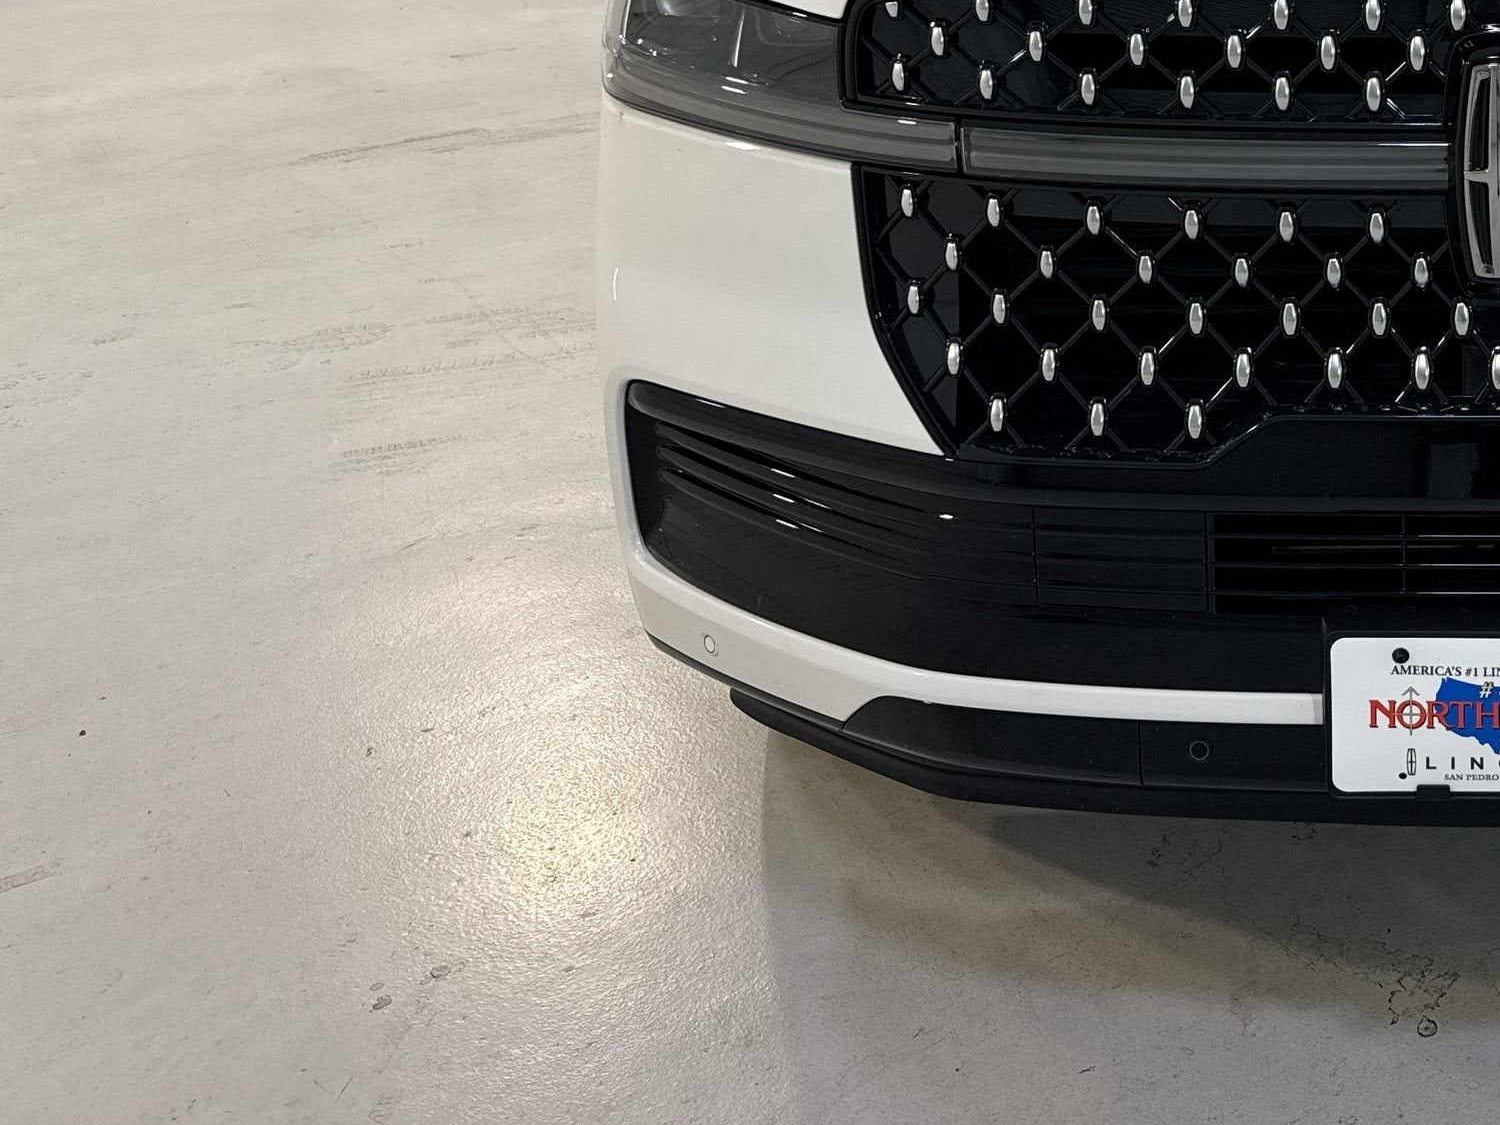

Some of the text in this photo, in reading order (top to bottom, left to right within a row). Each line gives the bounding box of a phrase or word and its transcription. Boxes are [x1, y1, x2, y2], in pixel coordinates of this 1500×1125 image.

[1390, 664, 1462, 676] AMERICA'S
[1465, 667, 1478, 677] #1
[1368, 699, 1500, 730] NORTH
